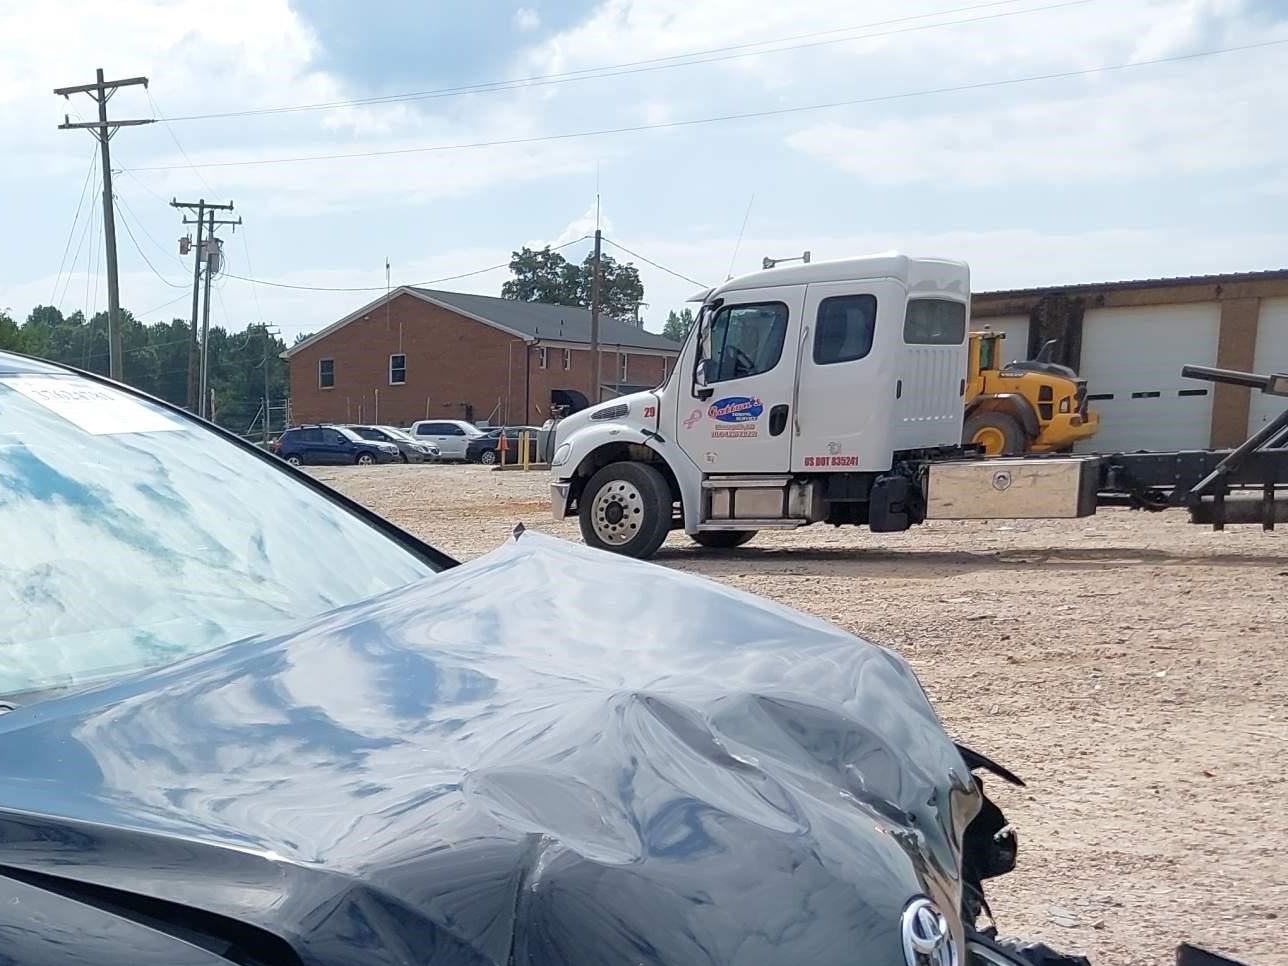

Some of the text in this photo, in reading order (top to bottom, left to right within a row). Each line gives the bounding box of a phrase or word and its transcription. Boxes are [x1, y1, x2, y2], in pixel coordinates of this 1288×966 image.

[804, 456, 859, 466] US DOT 835241
